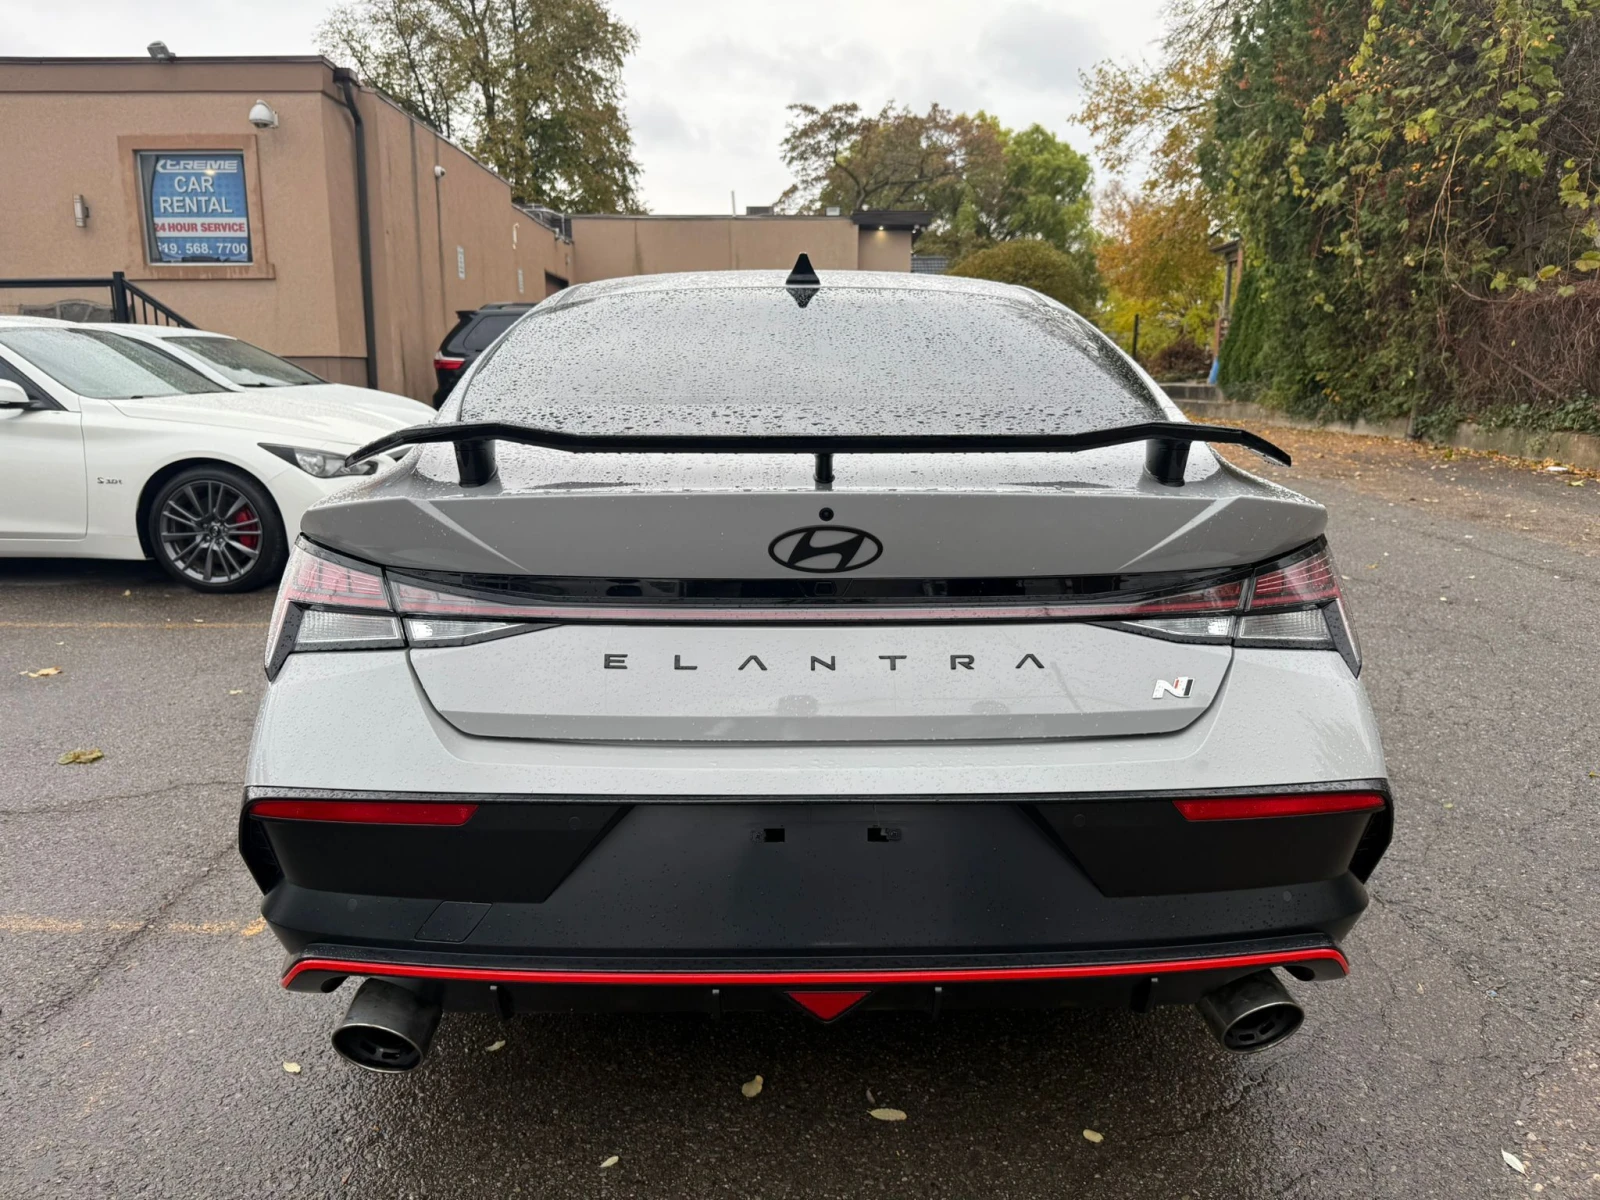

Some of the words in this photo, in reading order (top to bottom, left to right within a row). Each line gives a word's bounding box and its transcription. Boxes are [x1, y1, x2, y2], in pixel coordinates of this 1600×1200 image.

[174, 176, 214, 193] CAR
[160, 197, 233, 213] RENTAL
[168, 223, 198, 232] HOUR
[200, 223, 245, 232] SERVICE
[216, 243, 248, 254] 7700
[604, 653, 1045, 671] ELANTRA
[1152, 676, 1194, 699] N
